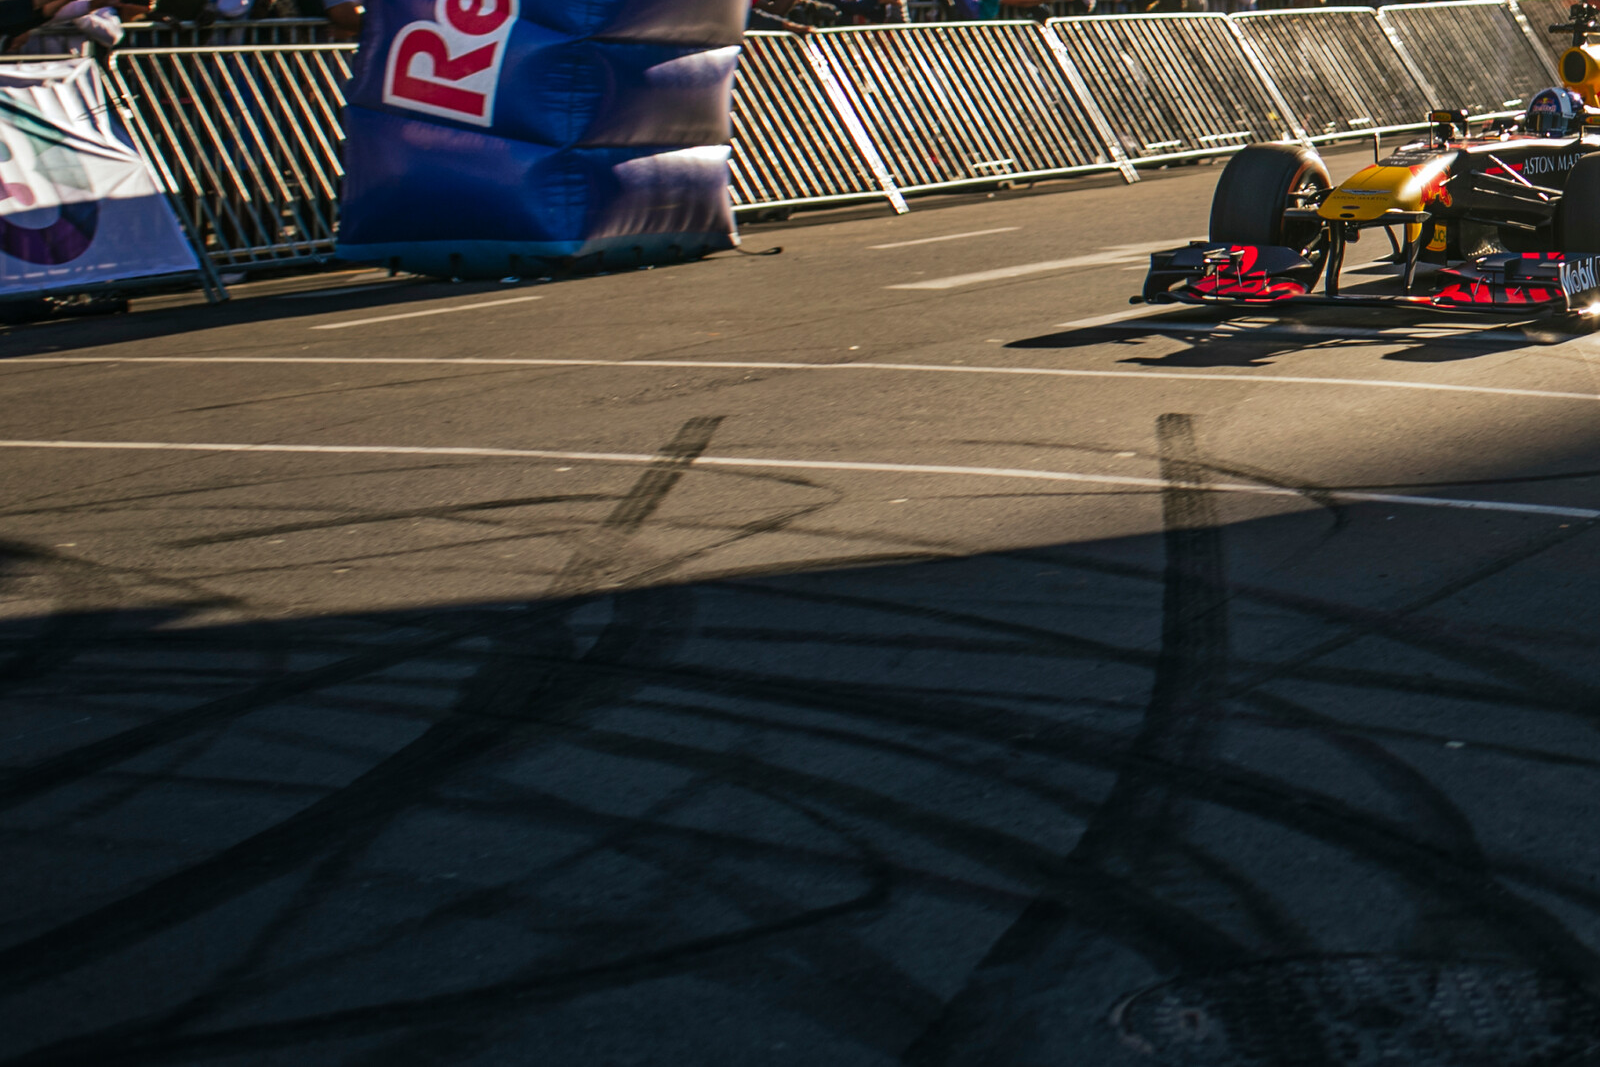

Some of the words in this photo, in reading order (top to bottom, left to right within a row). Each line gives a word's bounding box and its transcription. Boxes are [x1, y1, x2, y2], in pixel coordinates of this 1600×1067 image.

[1523, 156, 1554, 175] ASTON
[1557, 152, 1586, 171] MAR
[1560, 257, 1598, 295] Mobil
